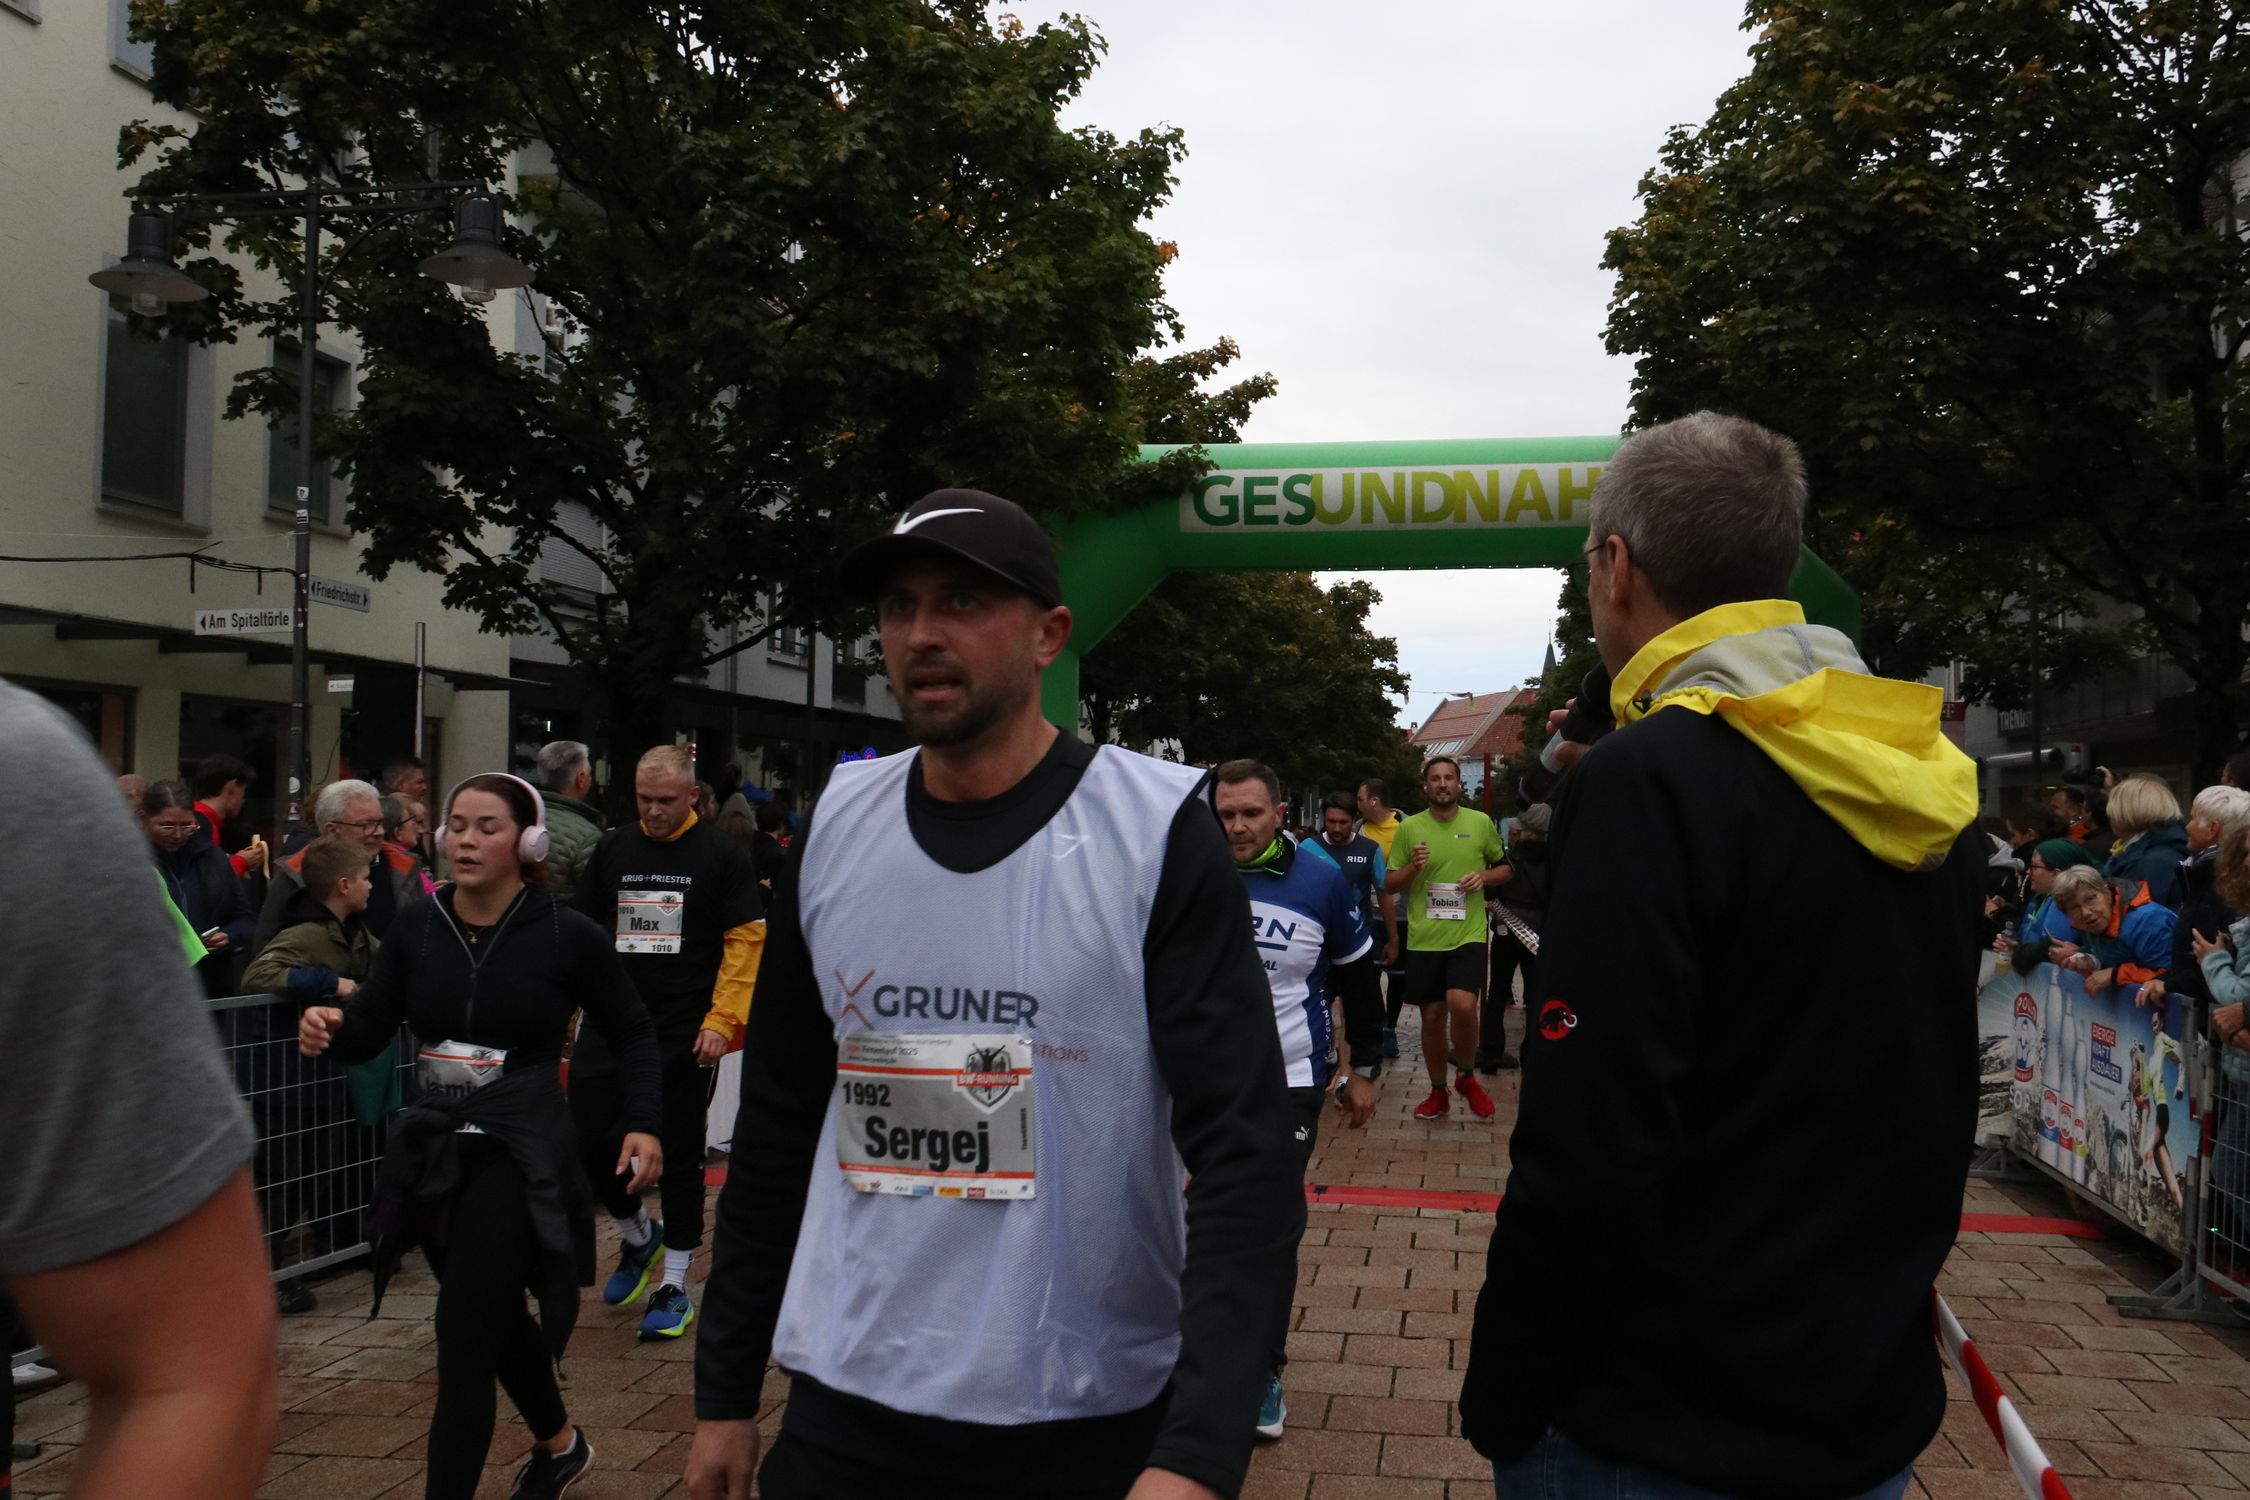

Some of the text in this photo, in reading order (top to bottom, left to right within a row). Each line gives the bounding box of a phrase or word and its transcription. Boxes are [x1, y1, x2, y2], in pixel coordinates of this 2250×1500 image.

[316, 582, 363, 605] Friedrichstr.
[209, 611, 289, 631] Am Spitaltörle
[1346, 854, 1367, 864] RIDI
[1432, 898, 1459, 907] Tobias
[630, 917, 660, 931] Max
[652, 944, 672, 953] 1010
[873, 985, 1039, 1029] GRUNER
[843, 1081, 892, 1107] 1992
[865, 1115, 990, 1173] Sergej
